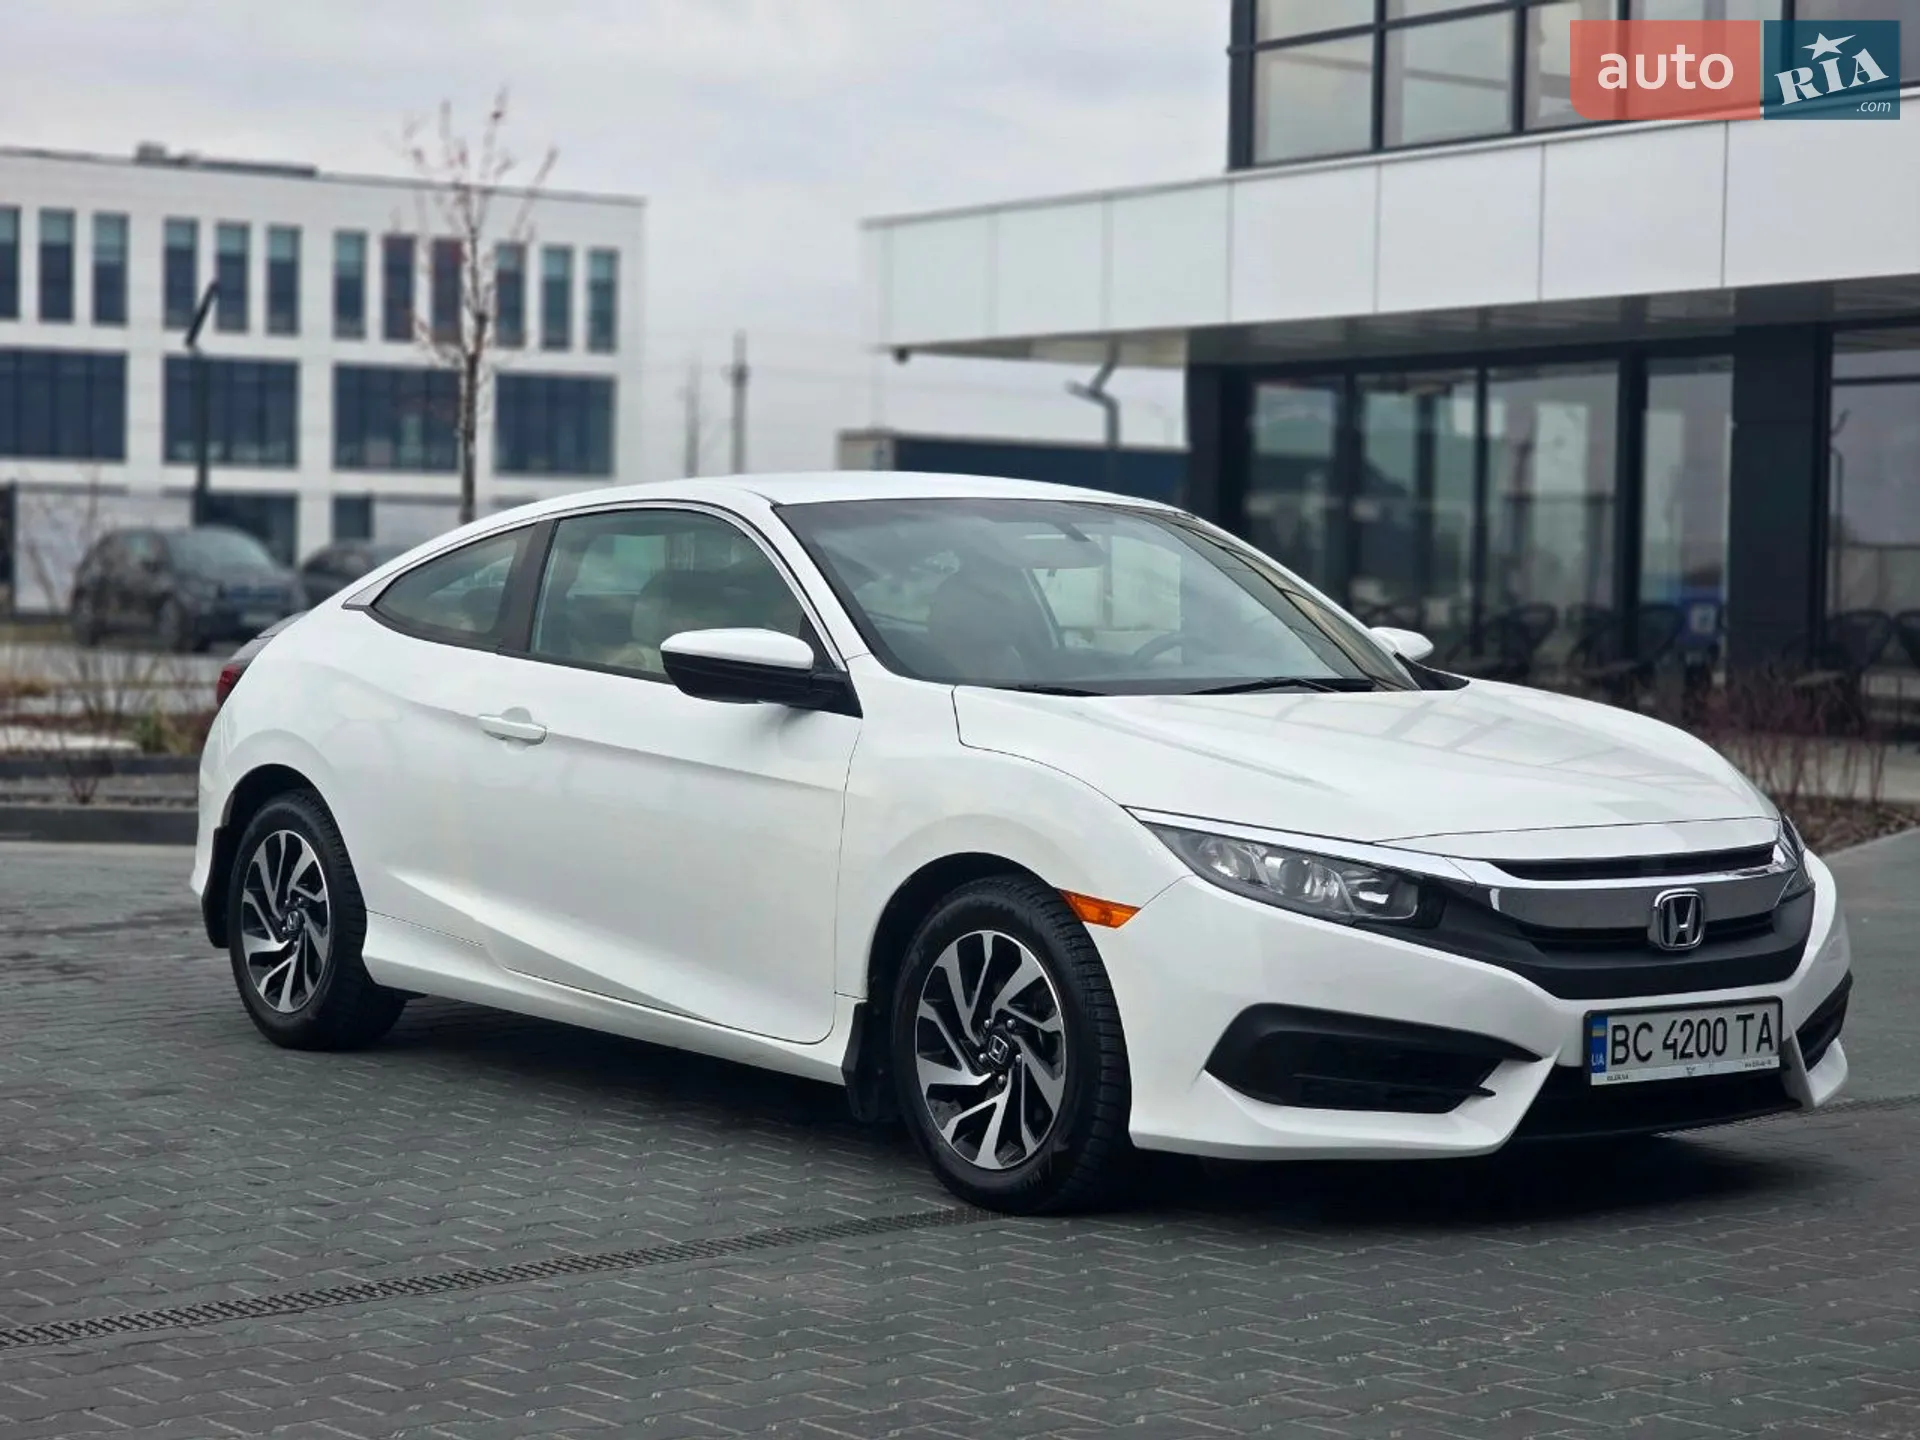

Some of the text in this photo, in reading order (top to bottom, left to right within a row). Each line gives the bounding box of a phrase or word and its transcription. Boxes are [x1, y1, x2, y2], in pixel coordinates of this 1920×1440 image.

[1610, 1012, 1774, 1066] BC 4200 TA
[1591, 1053, 1605, 1066] UA
